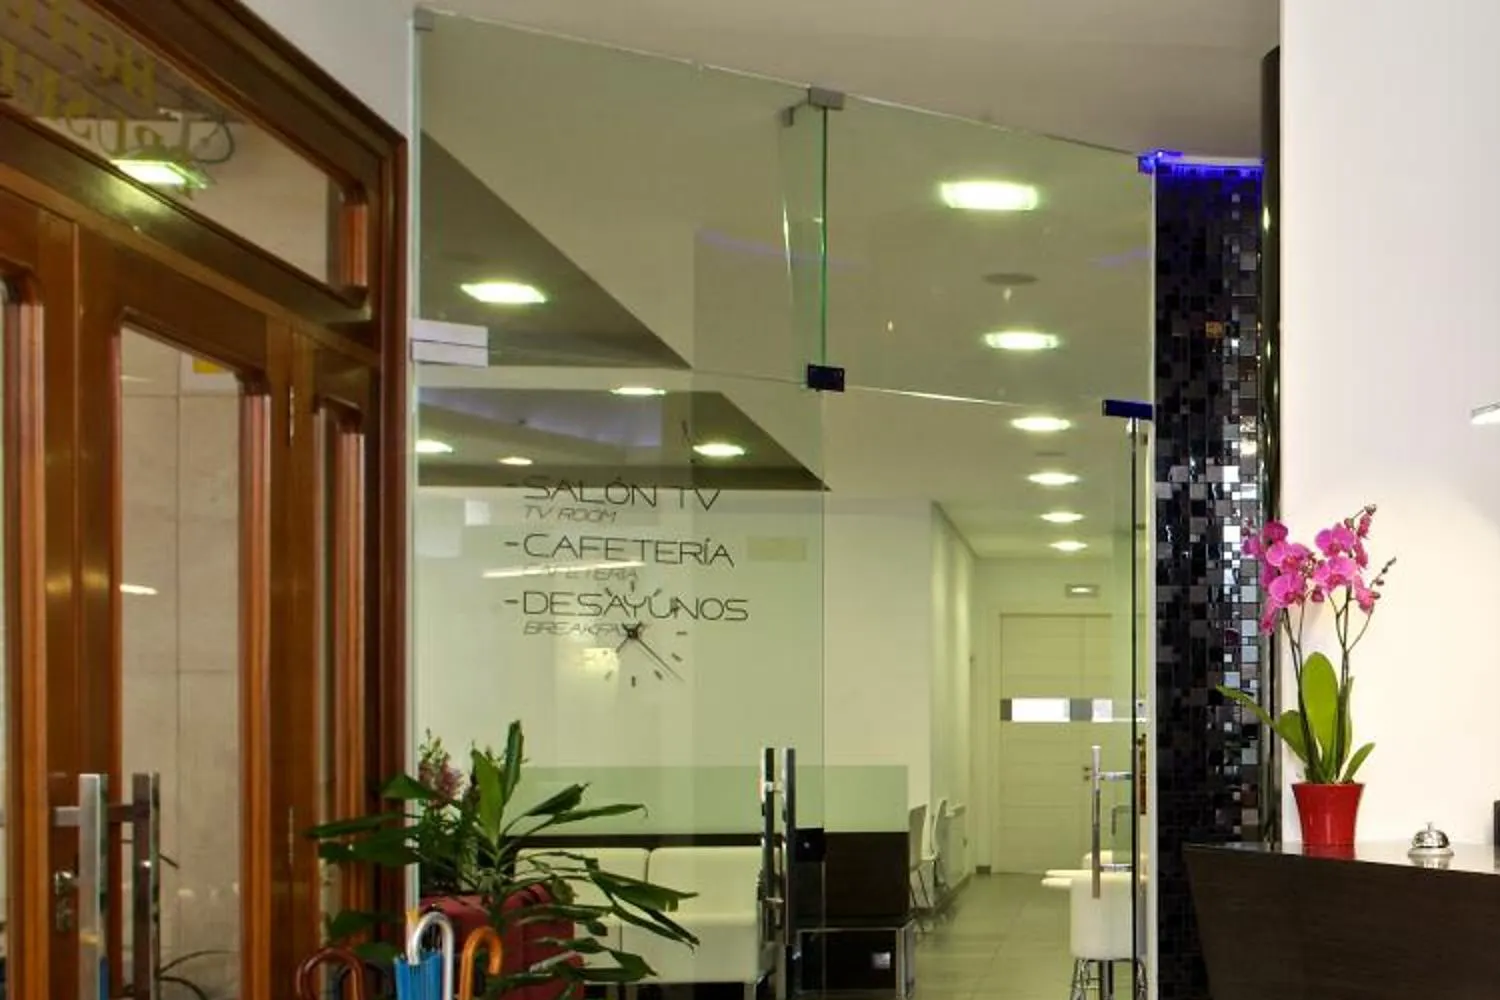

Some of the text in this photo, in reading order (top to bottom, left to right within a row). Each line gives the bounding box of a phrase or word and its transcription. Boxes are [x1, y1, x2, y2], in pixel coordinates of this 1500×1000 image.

[669, 485, 721, 511] TV
[523, 504, 618, 524] TV ROOM
